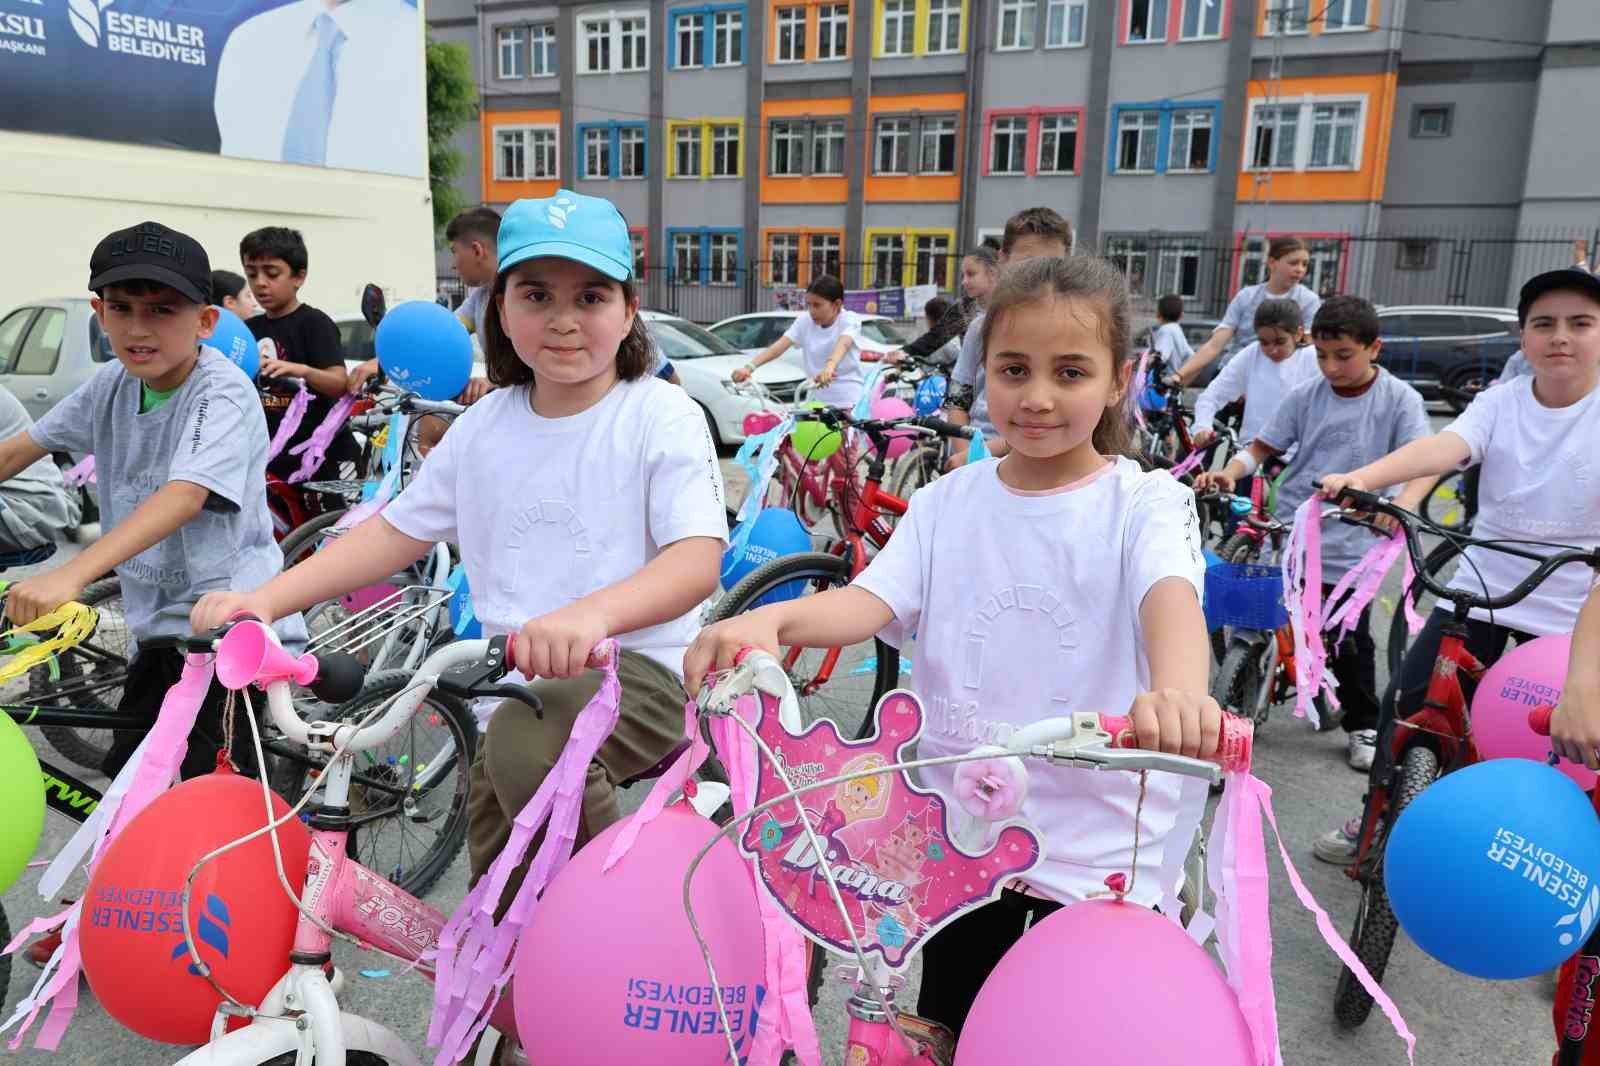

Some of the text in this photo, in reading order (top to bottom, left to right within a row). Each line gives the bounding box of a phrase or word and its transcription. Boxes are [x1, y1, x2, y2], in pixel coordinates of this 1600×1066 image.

[106, 10, 205, 48] ESENLER
[108, 34, 206, 66] BELEDİYESİ
[111, 233, 186, 265] QUEEN
[1495, 827, 1588, 889] BELEDİYESİ
[1487, 842, 1582, 908] ESENLER
[93, 906, 185, 933] ESENLER
[623, 1002, 744, 1034] ESENLER
